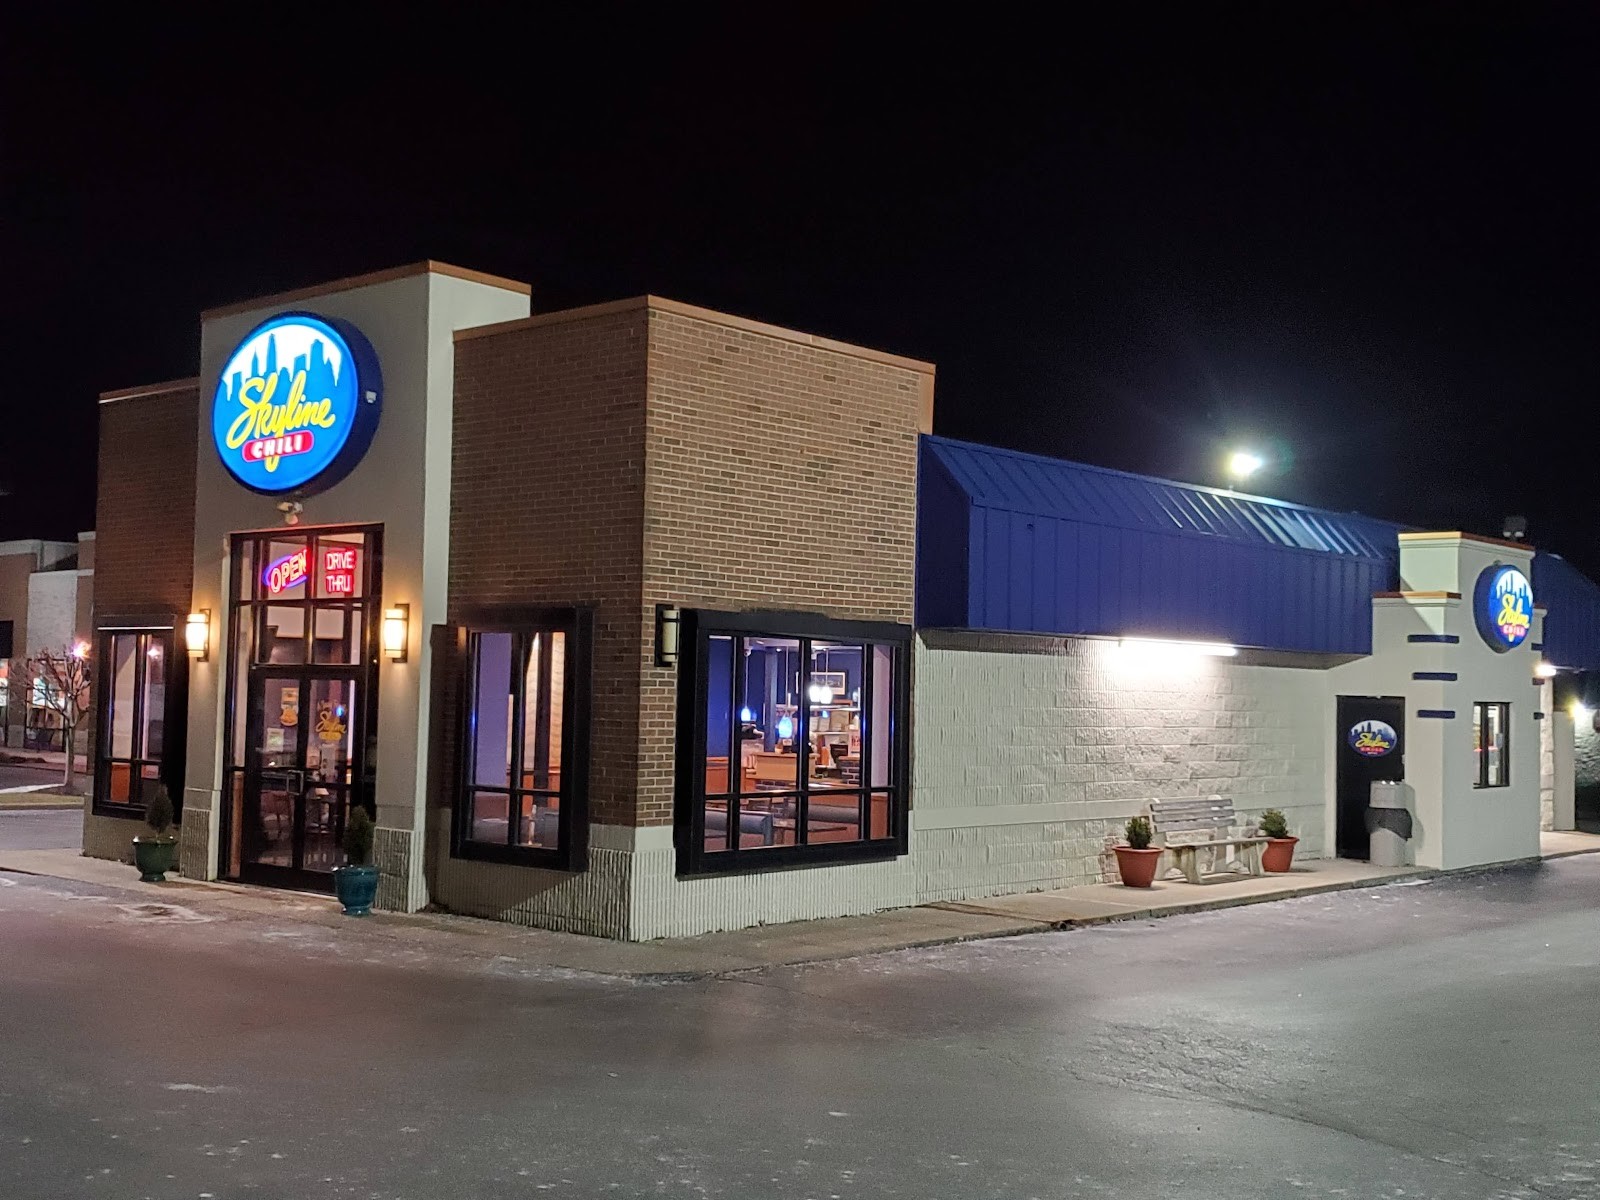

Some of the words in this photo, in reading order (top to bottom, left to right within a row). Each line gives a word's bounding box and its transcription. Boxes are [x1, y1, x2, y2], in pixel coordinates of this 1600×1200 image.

[226, 370, 336, 472] Skyline
[251, 434, 303, 458] CHILI
[271, 549, 308, 593] OPEN
[326, 551, 353, 570] DRIVE
[326, 575, 352, 592] THRU
